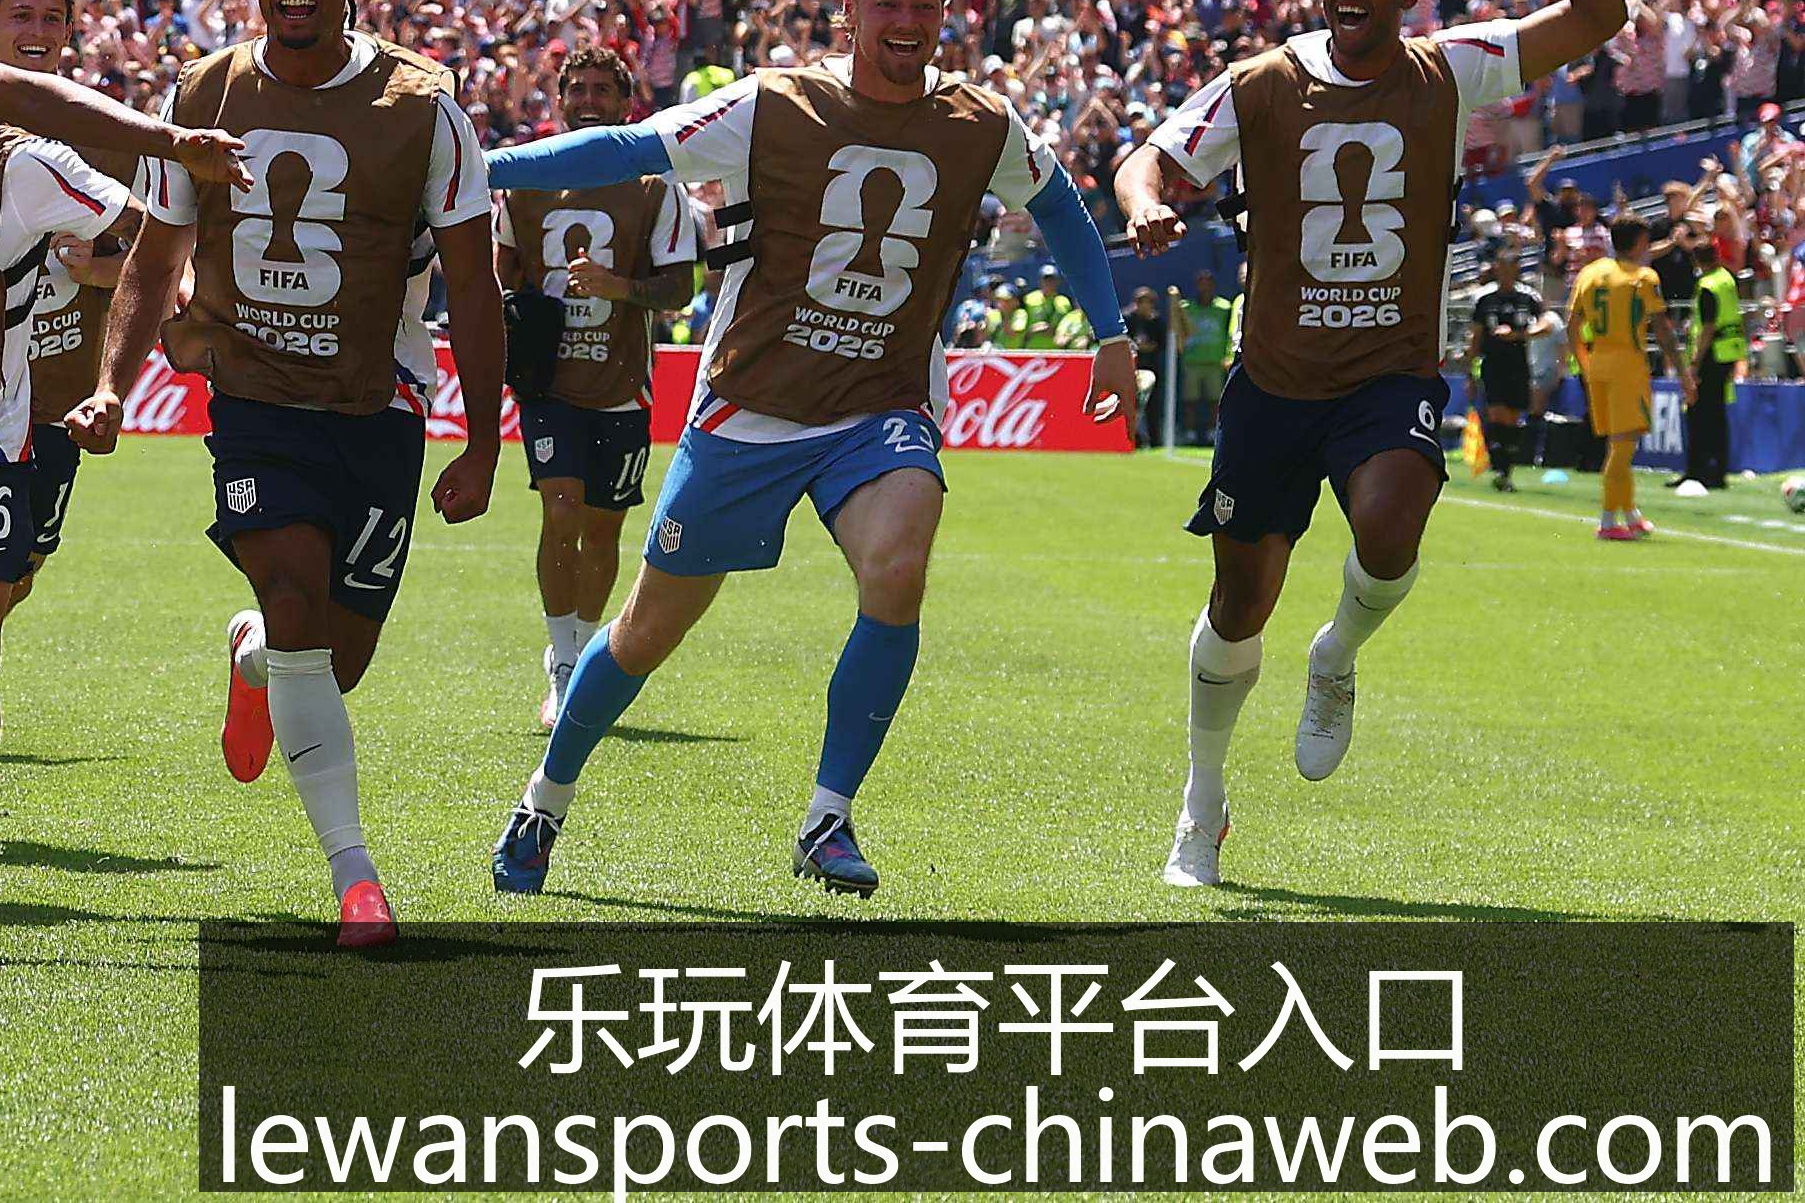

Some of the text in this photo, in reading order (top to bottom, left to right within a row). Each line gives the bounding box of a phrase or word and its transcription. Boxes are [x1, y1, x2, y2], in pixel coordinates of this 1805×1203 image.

[1330, 251, 1379, 268] FIFA
[259, 268, 309, 291] FIFA
[835, 277, 883, 302] FIFA
[1300, 286, 1402, 302] WORLD CUP
[52, 310, 81, 331] CUP
[235, 303, 340, 329] WORLD CUP
[795, 307, 896, 337] WORLD CUP
[1298, 305, 1402, 327] 2026
[585, 331, 610, 342] CUP
[783, 324, 886, 359] 2026
[557, 343, 608, 362] 026
[1418, 400, 1436, 431] 6
[616, 446, 647, 489] 10
[227, 479, 254, 495] USA
[345, 506, 407, 579] 12
